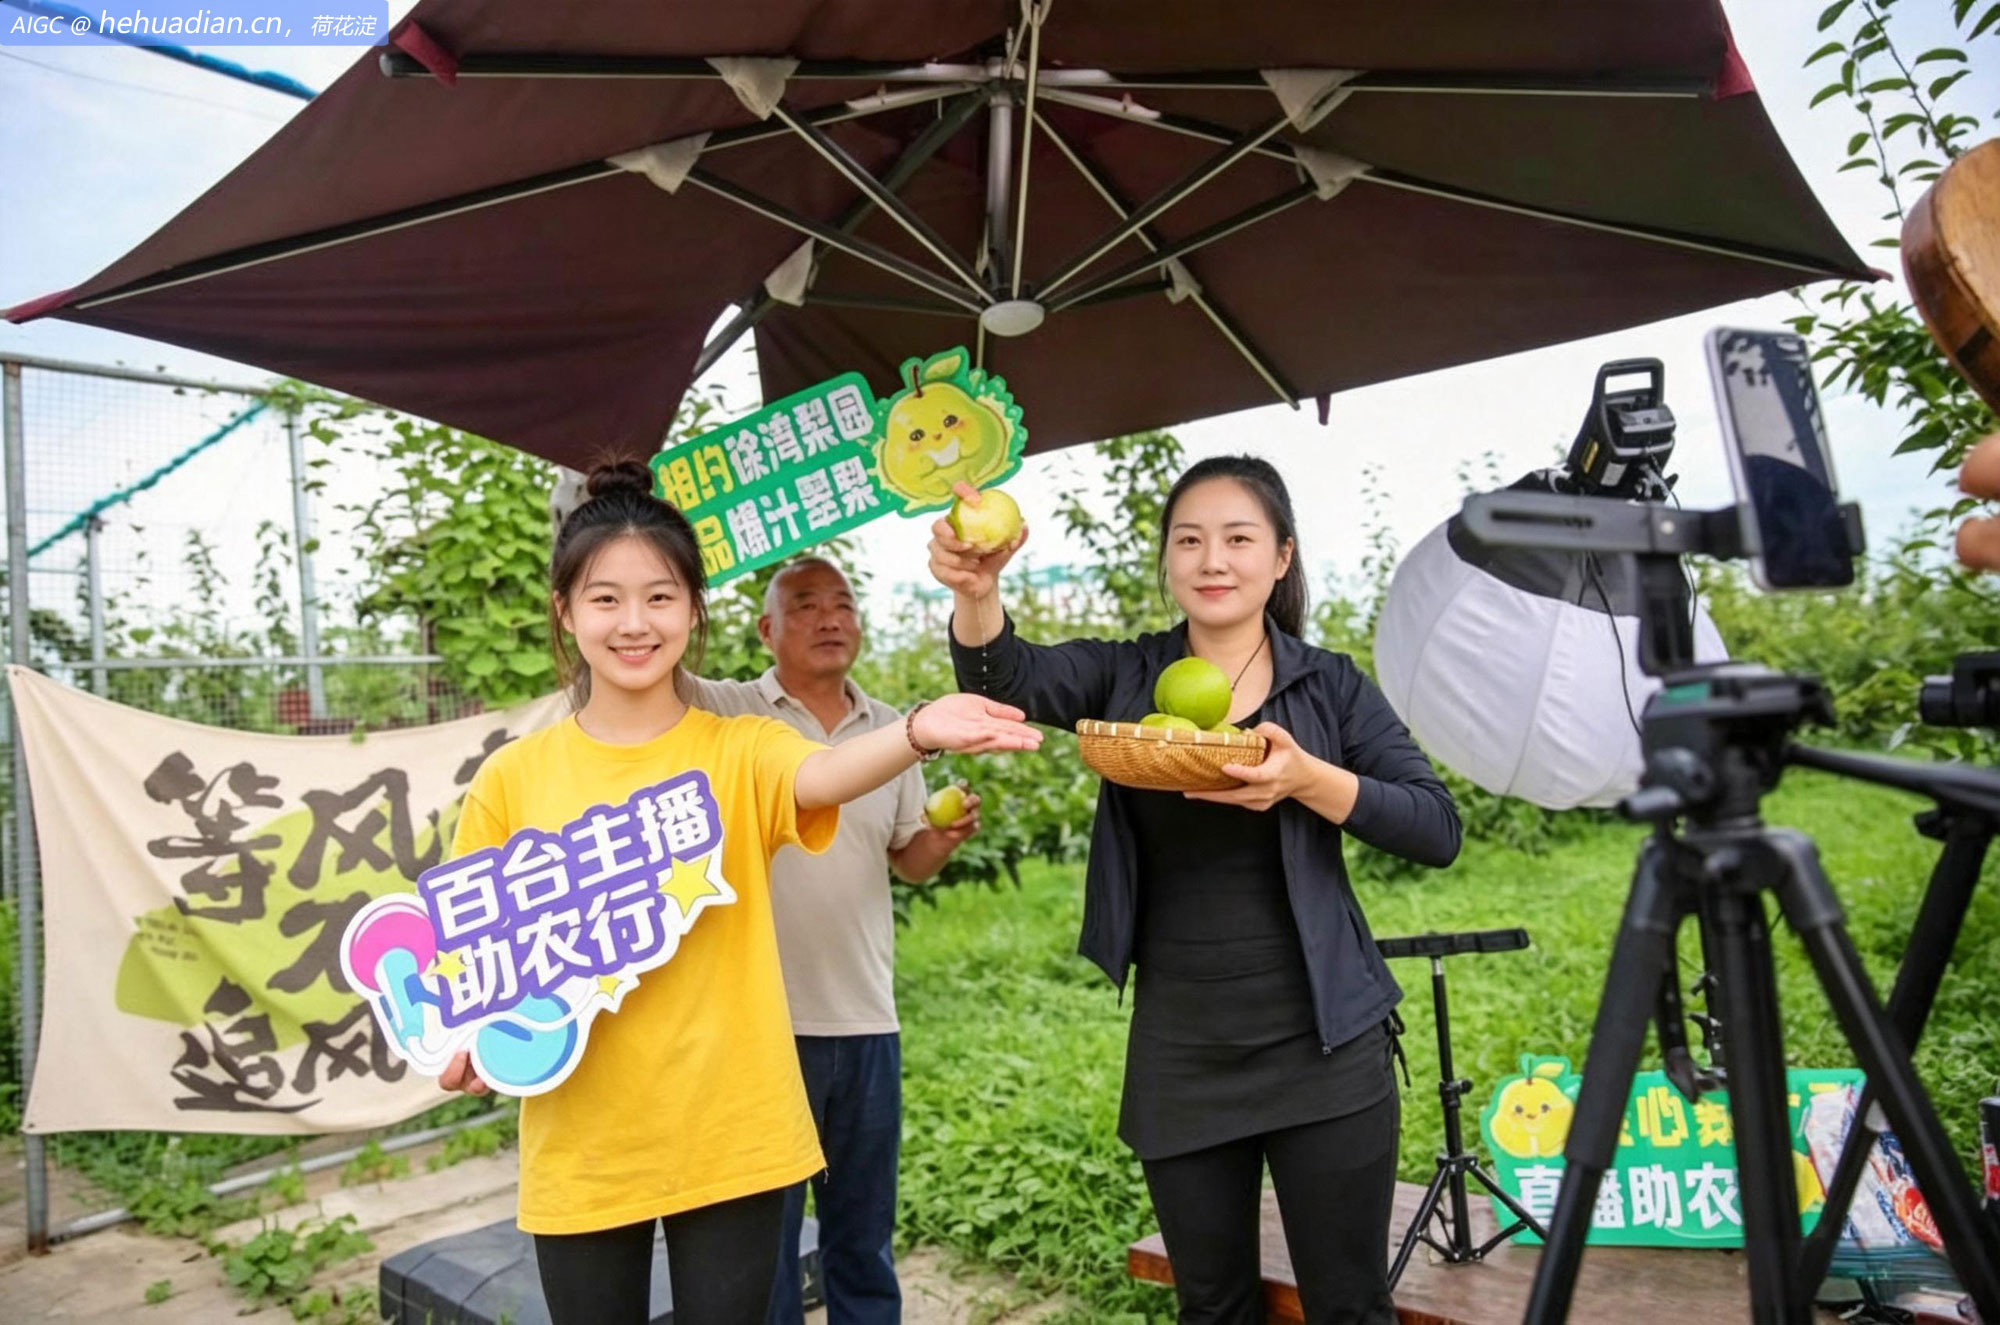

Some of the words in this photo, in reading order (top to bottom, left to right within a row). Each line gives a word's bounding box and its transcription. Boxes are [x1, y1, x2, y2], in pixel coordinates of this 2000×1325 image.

[144, 729, 519, 923] 等风
[427, 780, 712, 939] 百台主播
[446, 879, 656, 1017] 助农行
